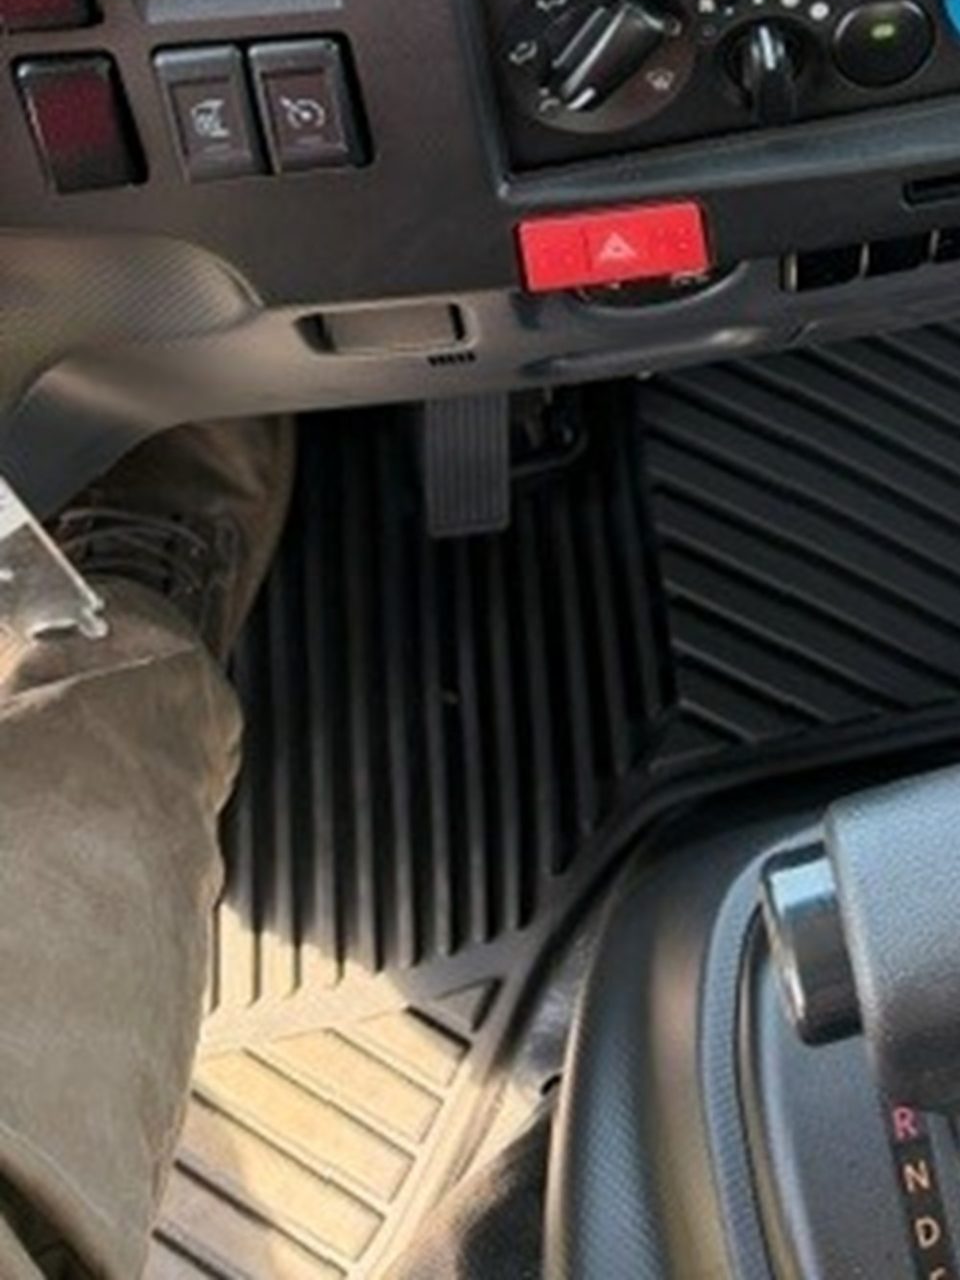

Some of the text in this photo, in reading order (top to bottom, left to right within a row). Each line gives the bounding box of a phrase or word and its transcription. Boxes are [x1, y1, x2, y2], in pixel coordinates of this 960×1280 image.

[892, 1105, 919, 1142] R
[903, 1158, 932, 1194] N
[914, 1216, 941, 1250] D
